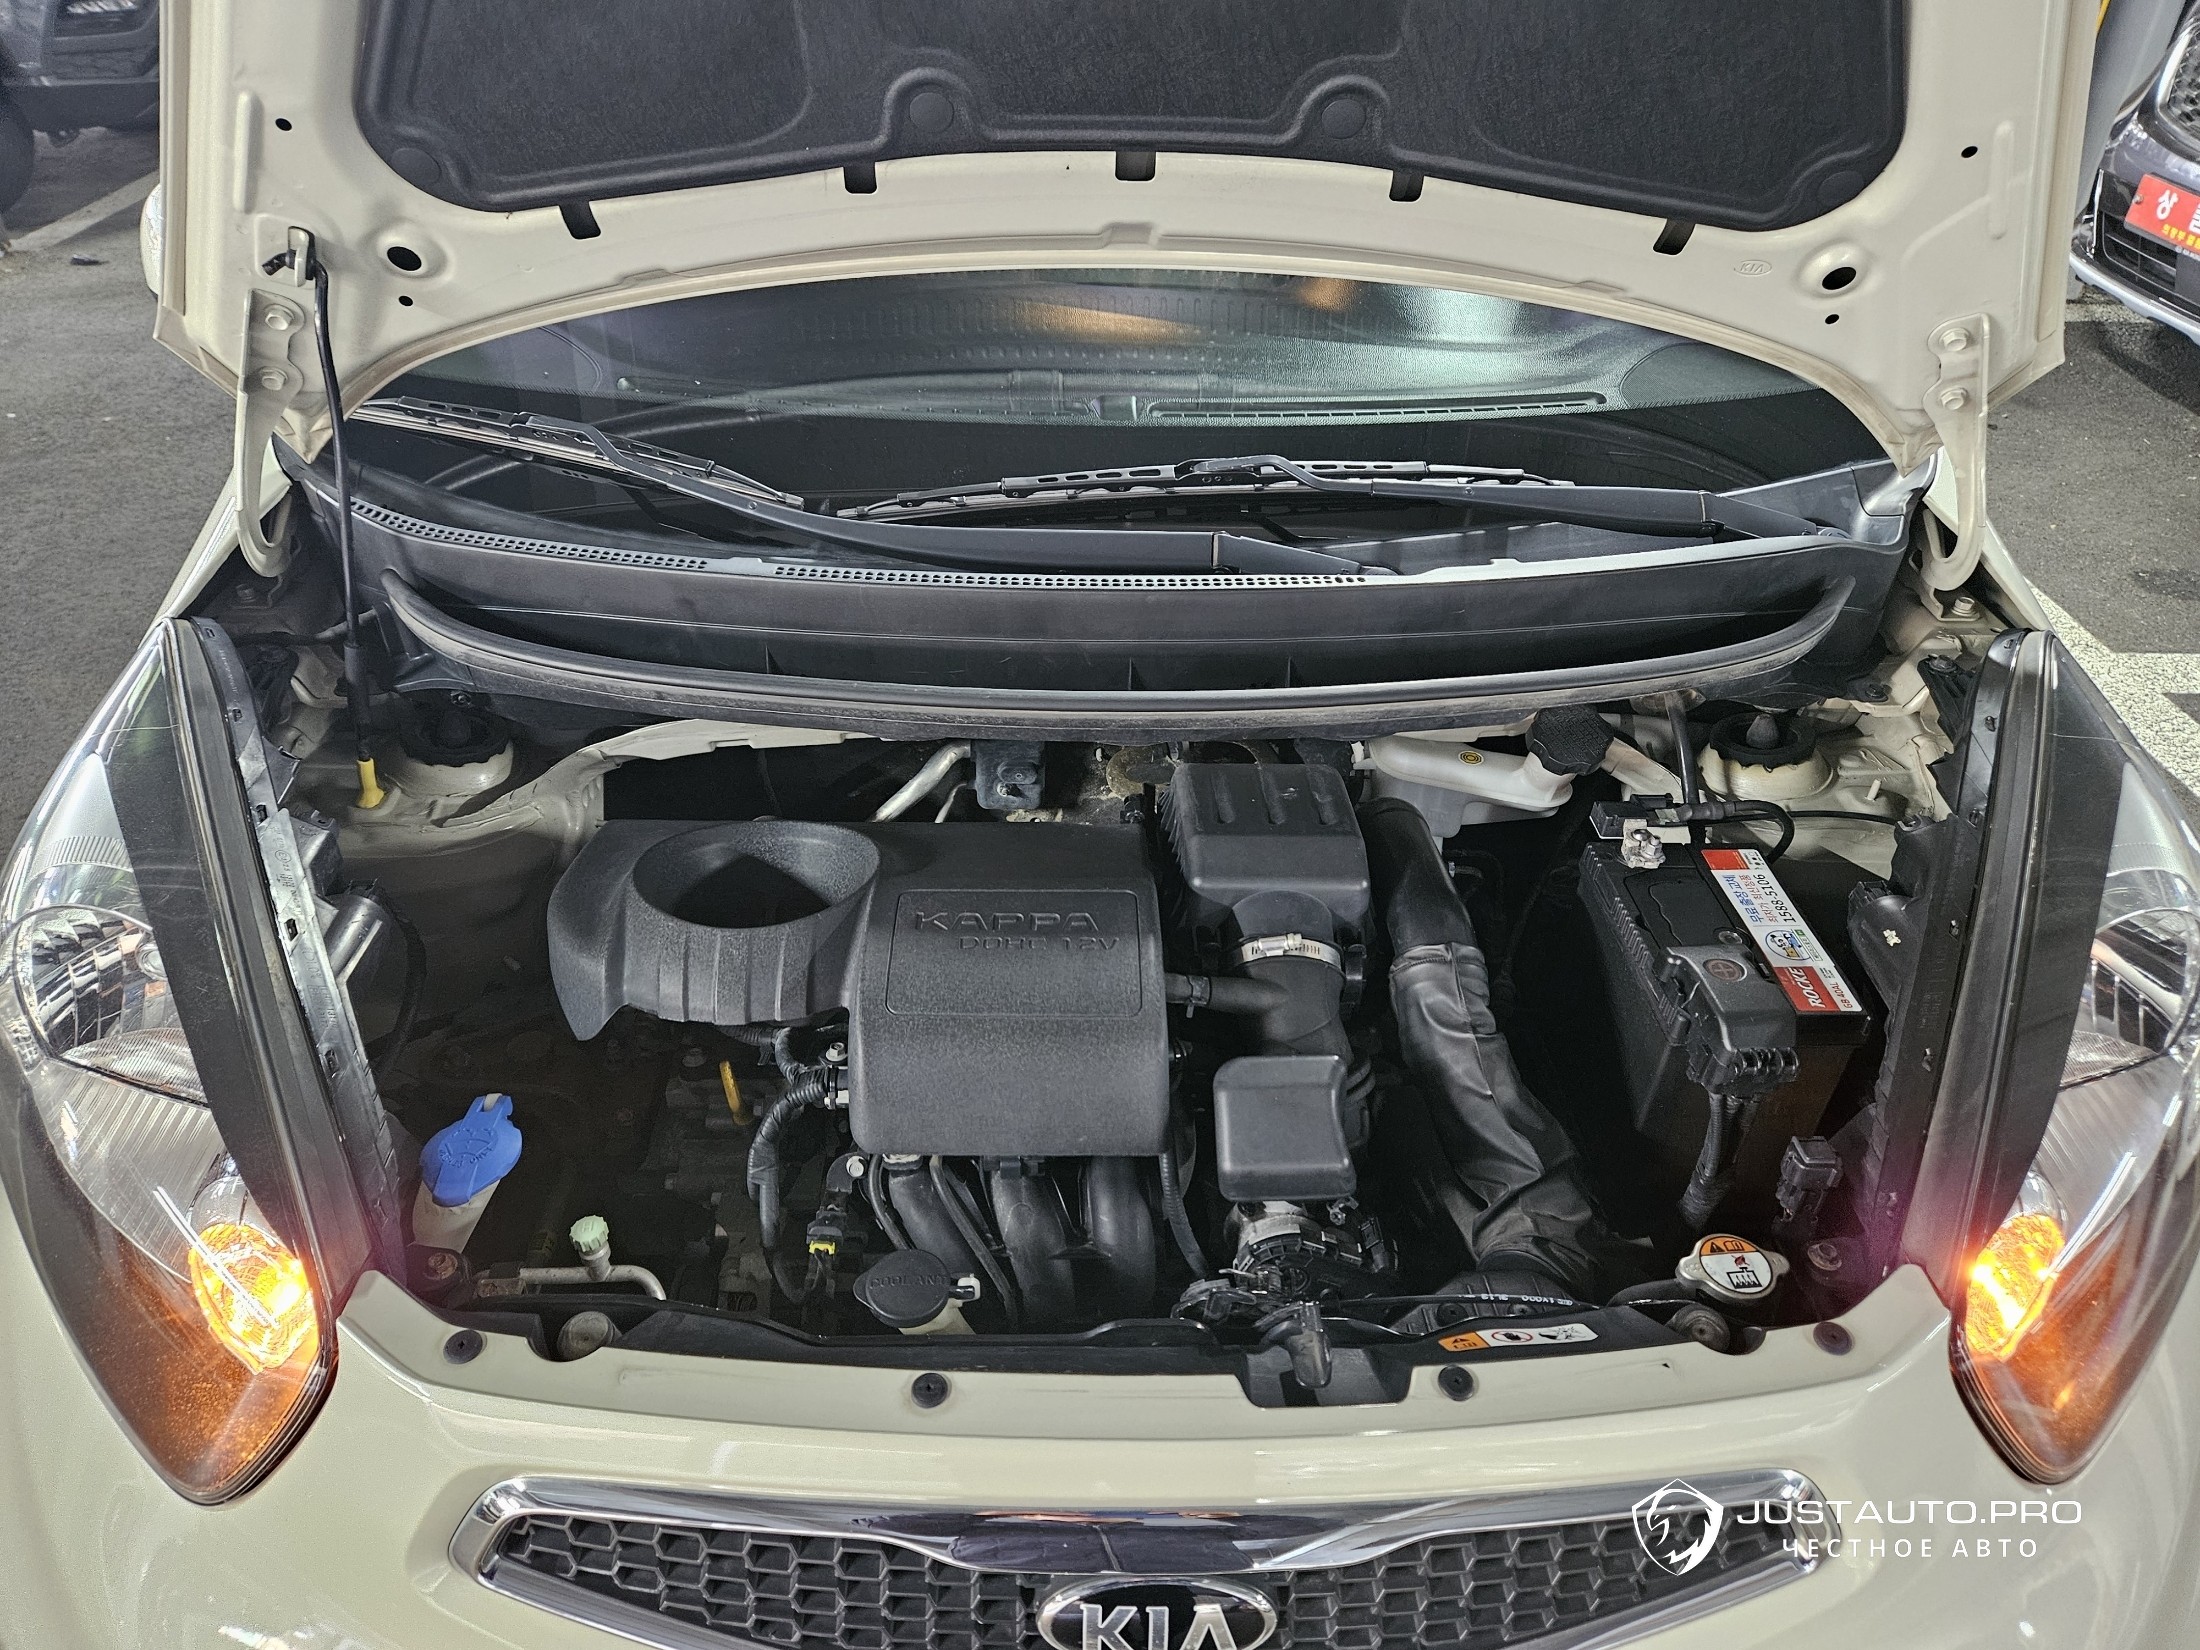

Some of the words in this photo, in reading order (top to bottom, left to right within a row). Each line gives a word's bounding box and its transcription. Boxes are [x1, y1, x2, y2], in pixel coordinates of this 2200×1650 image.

[1740, 262, 1764, 273] KIA
[1753, 874, 1796, 923] 1588-5106
[914, 911, 1100, 932] KAPPA
[959, 936, 1048, 950] DOHC
[1061, 936, 1120, 950] 12V
[1790, 967, 1826, 1009] ROCKE
[1841, 997, 1853, 1010] GB
[869, 1274, 948, 1289] COOLANT
[1080, 1604, 1238, 1650] KIA
